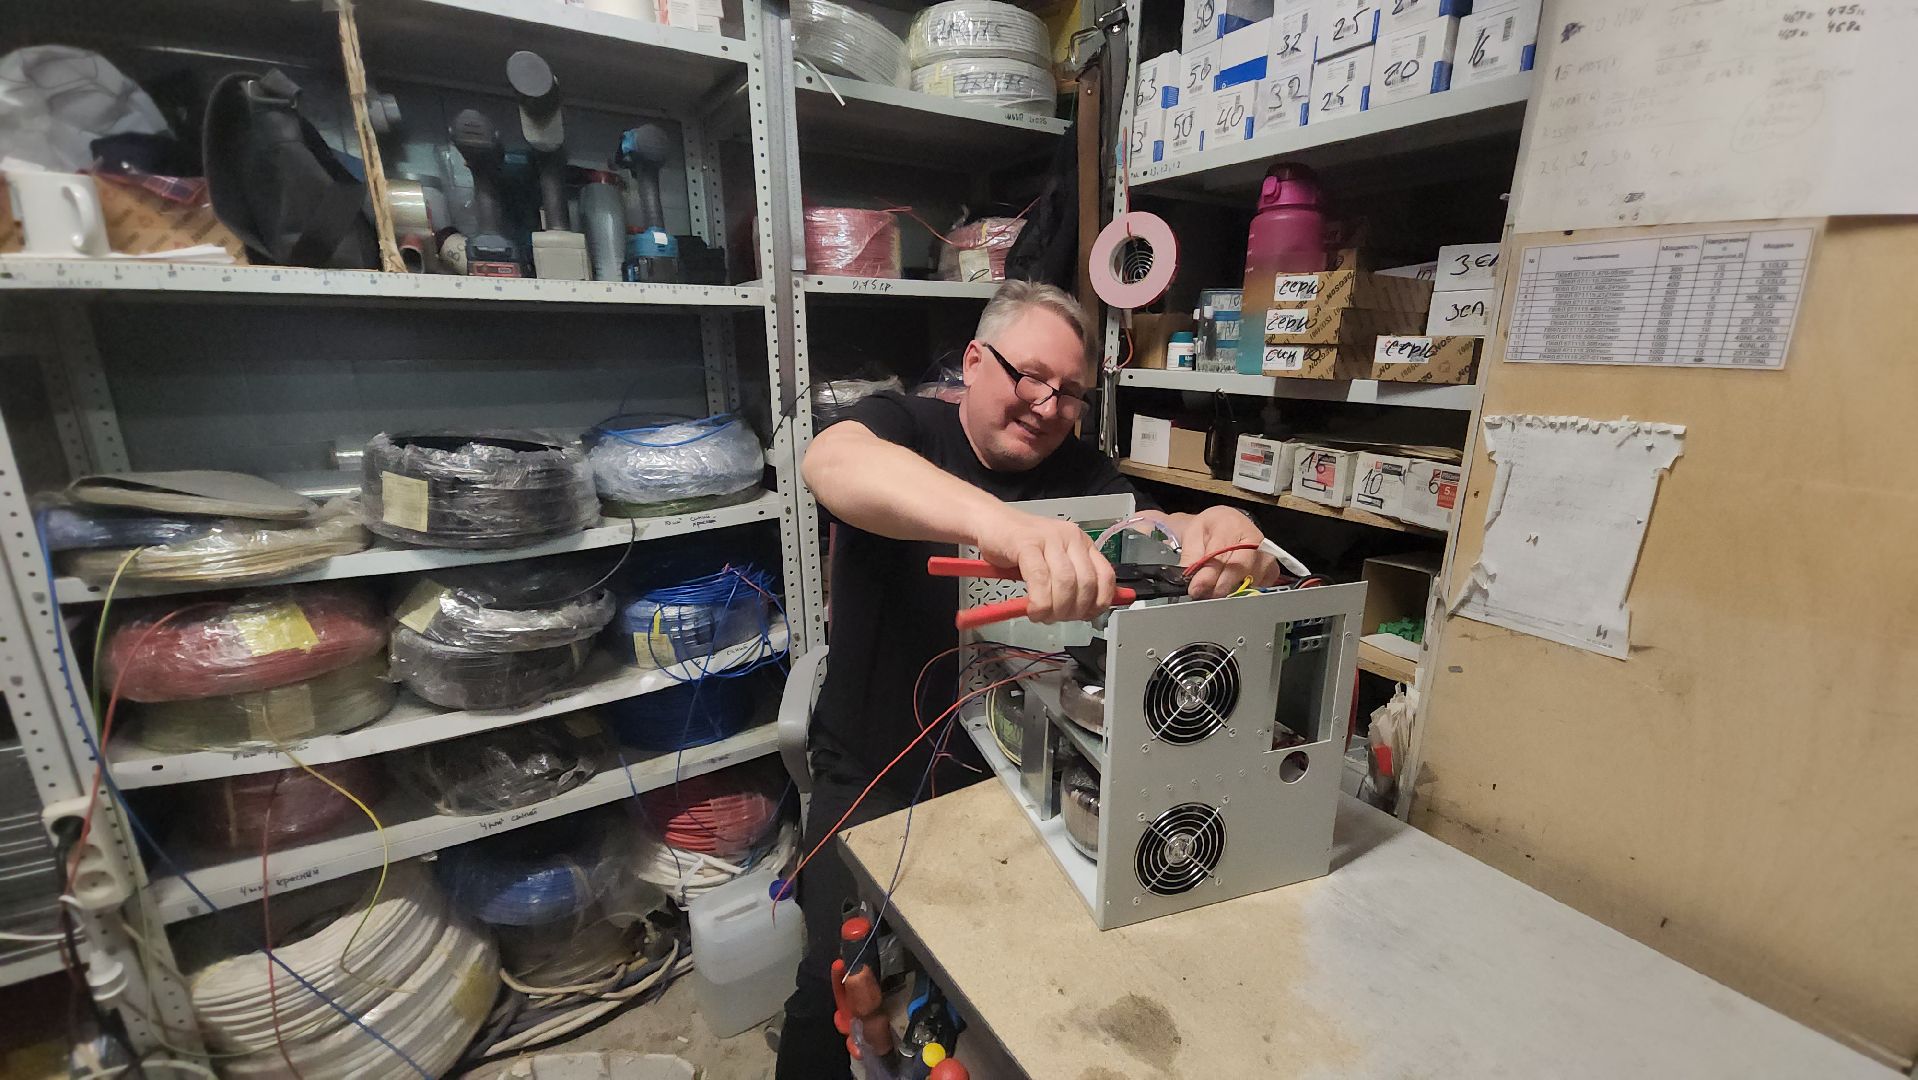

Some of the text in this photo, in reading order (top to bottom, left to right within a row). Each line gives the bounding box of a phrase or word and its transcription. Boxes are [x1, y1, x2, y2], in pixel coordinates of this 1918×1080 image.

[1332, 7, 1370, 41] 25
[1276, 32, 1302, 55] 32
[1467, 28, 1490, 66] 16
[1186, 63, 1212, 89] 50
[1135, 78, 1157, 107] 63
[1270, 76, 1310, 110] 32
[1320, 84, 1350, 112] 25
[1172, 112, 1194, 141] 50
[1216, 104, 1245, 134] 40
[1131, 131, 1144, 153] 3
[1361, 468, 1384, 495] 10
